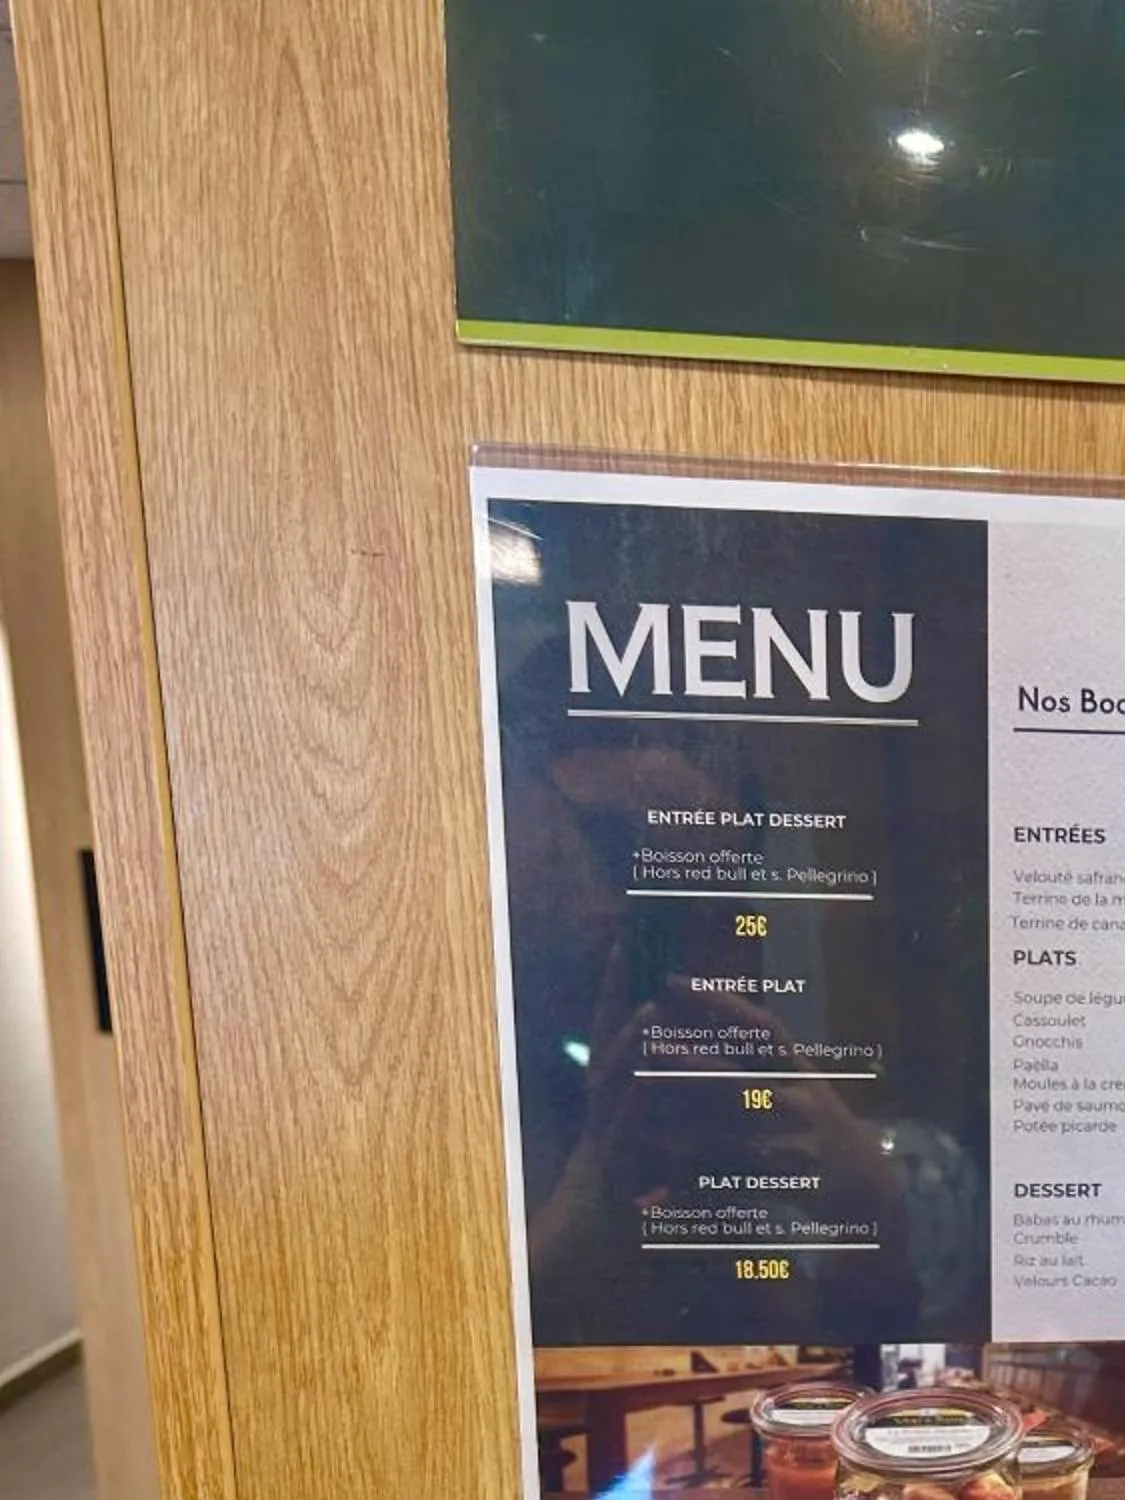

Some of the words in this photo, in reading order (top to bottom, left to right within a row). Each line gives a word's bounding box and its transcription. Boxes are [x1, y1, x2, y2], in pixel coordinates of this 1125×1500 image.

[566, 601, 915, 702] MENU
[1019, 686, 1071, 712] Nos
[648, 809, 716, 824] ENTRÉE
[721, 812, 764, 826] PLAT
[770, 814, 847, 828] DESSERT
[1014, 825, 1106, 844] ENTRÉES
[710, 850, 764, 864] offerte
[643, 866, 680, 880] Hors
[686, 867, 711, 880] red
[718, 867, 746, 881] bull
[752, 869, 766, 881] et
[788, 869, 868, 886] Pellegrino
[1013, 892, 1068, 905] Terrine
[1071, 892, 1090, 907] de
[1095, 892, 1109, 907] la
[735, 915, 767, 937] 25€
[1011, 917, 1064, 929] Terrine
[1068, 917, 1088, 931] de
[1014, 951, 1077, 966] PLATS
[691, 976, 757, 992] ENTRÉE
[763, 980, 806, 993] PLAT
[1015, 992, 1062, 1006] Soupe
[1065, 992, 1086, 1004] de
[1013, 1013, 1086, 1027] Cassoulet
[718, 1026, 771, 1040] offerte
[1013, 1034, 1083, 1049] Gnocchis
[651, 1042, 689, 1055] Hors
[694, 1043, 720, 1056] red
[725, 1043, 753, 1056] bull
[758, 1044, 772, 1056] et
[794, 1044, 873, 1060] Pellegrino
[1013, 1078, 1067, 1091] Moules
[1084, 1078, 1096, 1090] la
[742, 1089, 772, 1109] 19€
[1054, 1100, 1072, 1112] de
[1061, 1120, 1117, 1134] picarde
[700, 1176, 739, 1188] PLAT
[746, 1176, 820, 1189] DESSERT
[1014, 1183, 1102, 1197] DESSERT
[716, 1207, 768, 1220] offerte
[1013, 1213, 1059, 1226] Babas
[1063, 1215, 1081, 1226] au
[651, 1222, 688, 1234] Hors
[692, 1222, 717, 1235] red
[724, 1222, 752, 1235] bull
[756, 1223, 771, 1235] et
[792, 1222, 869, 1237] Pellegrino
[1013, 1231, 1080, 1246] Crumble
[1040, 1256, 1058, 1267] au
[1061, 1253, 1084, 1267] lait
[736, 1260, 789, 1279] 18.50€
[1013, 1275, 1068, 1288] Velours
[1072, 1272, 1117, 1288] Cacao
